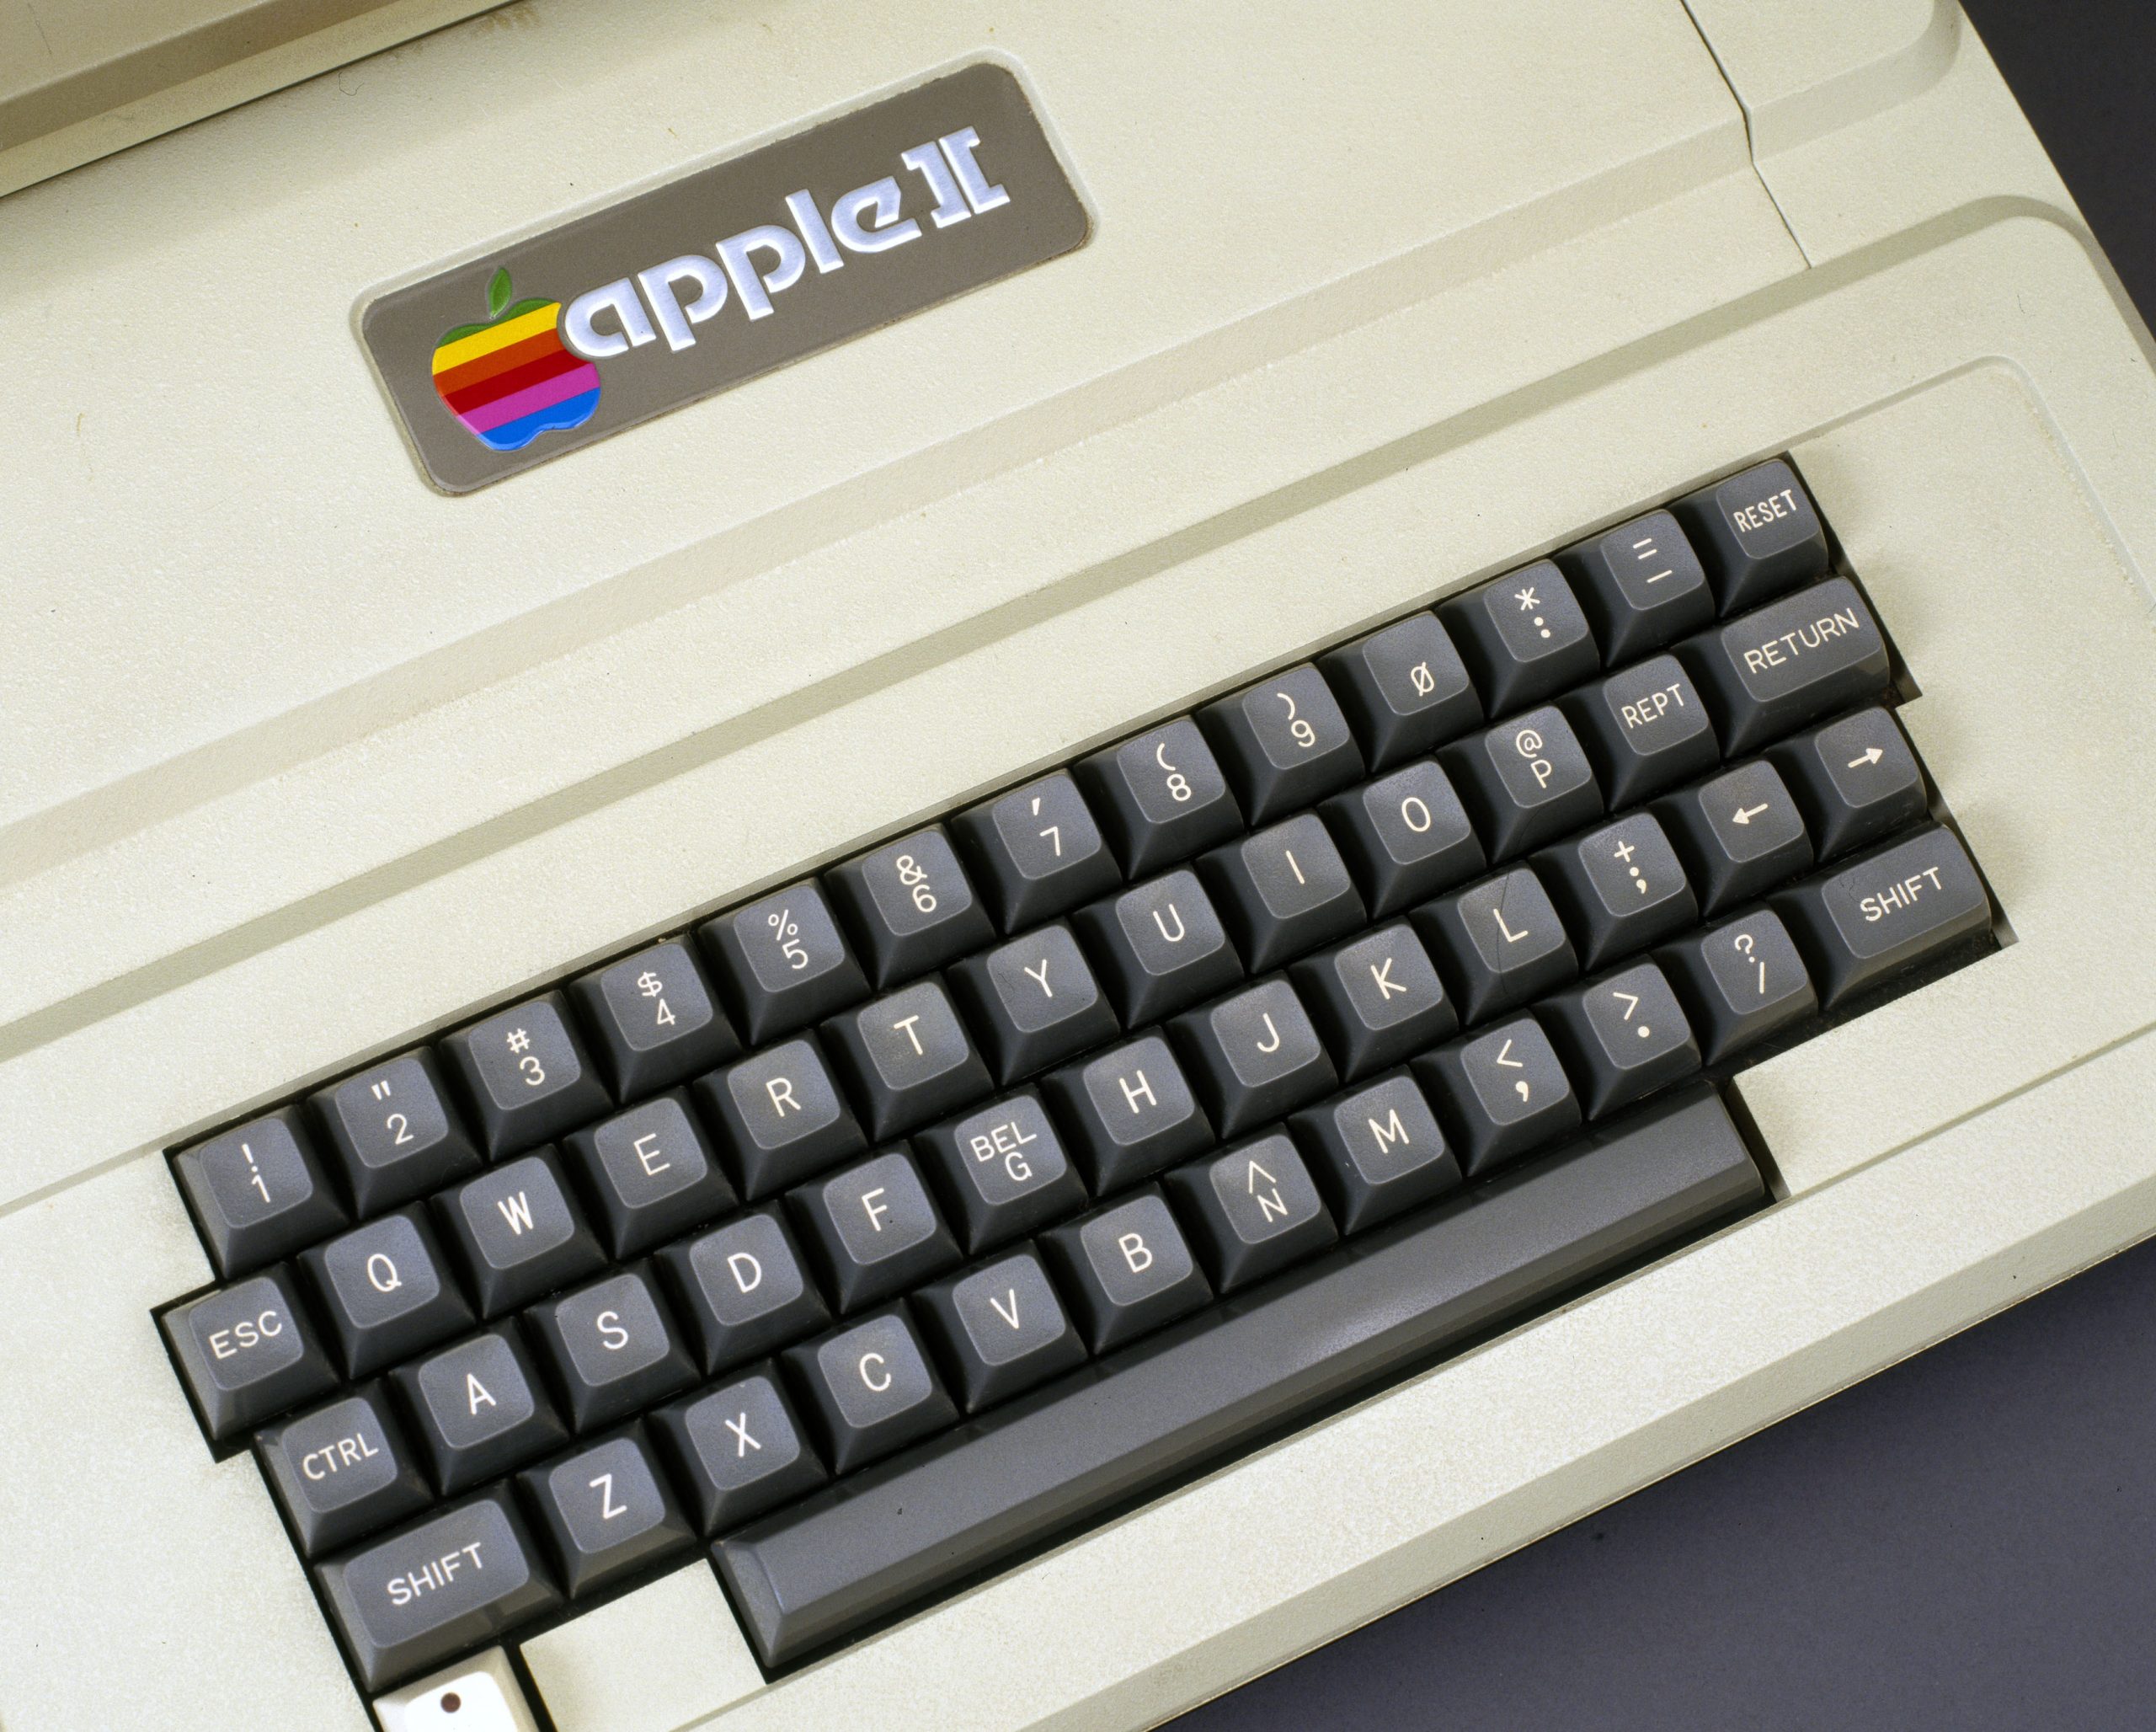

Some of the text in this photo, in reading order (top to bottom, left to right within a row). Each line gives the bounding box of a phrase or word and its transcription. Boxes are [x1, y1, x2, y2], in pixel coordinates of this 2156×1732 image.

[563, 177, 922, 358] apple
[1732, 489, 1797, 532] RESET
[1632, 537, 1657, 560] =
[1534, 617, 1551, 639] :
[1743, 607, 1860, 674] RETURN
[1276, 692, 1296, 720] )
[1620, 682, 1684, 729] REPT
[1290, 719, 1315, 748] 9
[1515, 729, 1543, 758] @
[1155, 742, 1177, 772] (
[1529, 759, 1552, 788] P
[1166, 773, 1192, 802] 8
[1401, 796, 1431, 832] O
[1039, 826, 1061, 857] 7
[1614, 840, 1635, 863] +
[896, 854, 928, 884] &
[1285, 850, 1305, 885] I
[1629, 866, 1646, 894] ;
[909, 880, 937, 913] 6
[1860, 866, 1942, 922] SHIFT
[767, 909, 798, 940] %
[1152, 903, 1185, 942] U
[1492, 908, 1529, 943] L
[782, 938, 808, 970] 5
[1734, 933, 1755, 963] ?
[637, 971, 663, 997] $
[1023, 959, 1053, 998] Y
[1370, 957, 1407, 1000] K
[1758, 961, 1765, 994] /
[657, 997, 676, 1025] 4
[1612, 992, 1639, 1021] >
[506, 1028, 531, 1054] #
[893, 1014, 923, 1056] T
[1257, 1013, 1280, 1053] J
[1496, 1039, 1524, 1067] <
[520, 1056, 546, 1086] 3
[766, 1077, 802, 1117] R
[1118, 1069, 1157, 1114] H
[387, 1113, 414, 1145] 2
[969, 1121, 1038, 1163] BEL
[1368, 1109, 1410, 1154] M
[242, 1143, 259, 1173] !
[633, 1132, 670, 1176] E
[1004, 1151, 1033, 1181] G
[251, 1173, 271, 1203] 1
[1257, 1187, 1289, 1222] N
[497, 1190, 534, 1235] W
[861, 1187, 888, 1232] F
[1118, 1232, 1153, 1273] B
[367, 1253, 403, 1292] Q
[727, 1252, 762, 1293] D
[990, 1288, 1019, 1329] V
[209, 1310, 283, 1360] ESC
[596, 1311, 629, 1350] S
[859, 1352, 892, 1392] C
[467, 1373, 497, 1415] A
[725, 1410, 761, 1459] X
[302, 1432, 379, 1479] CTRL
[589, 1473, 627, 1520] Z
[387, 1542, 483, 1606] SHIFT
